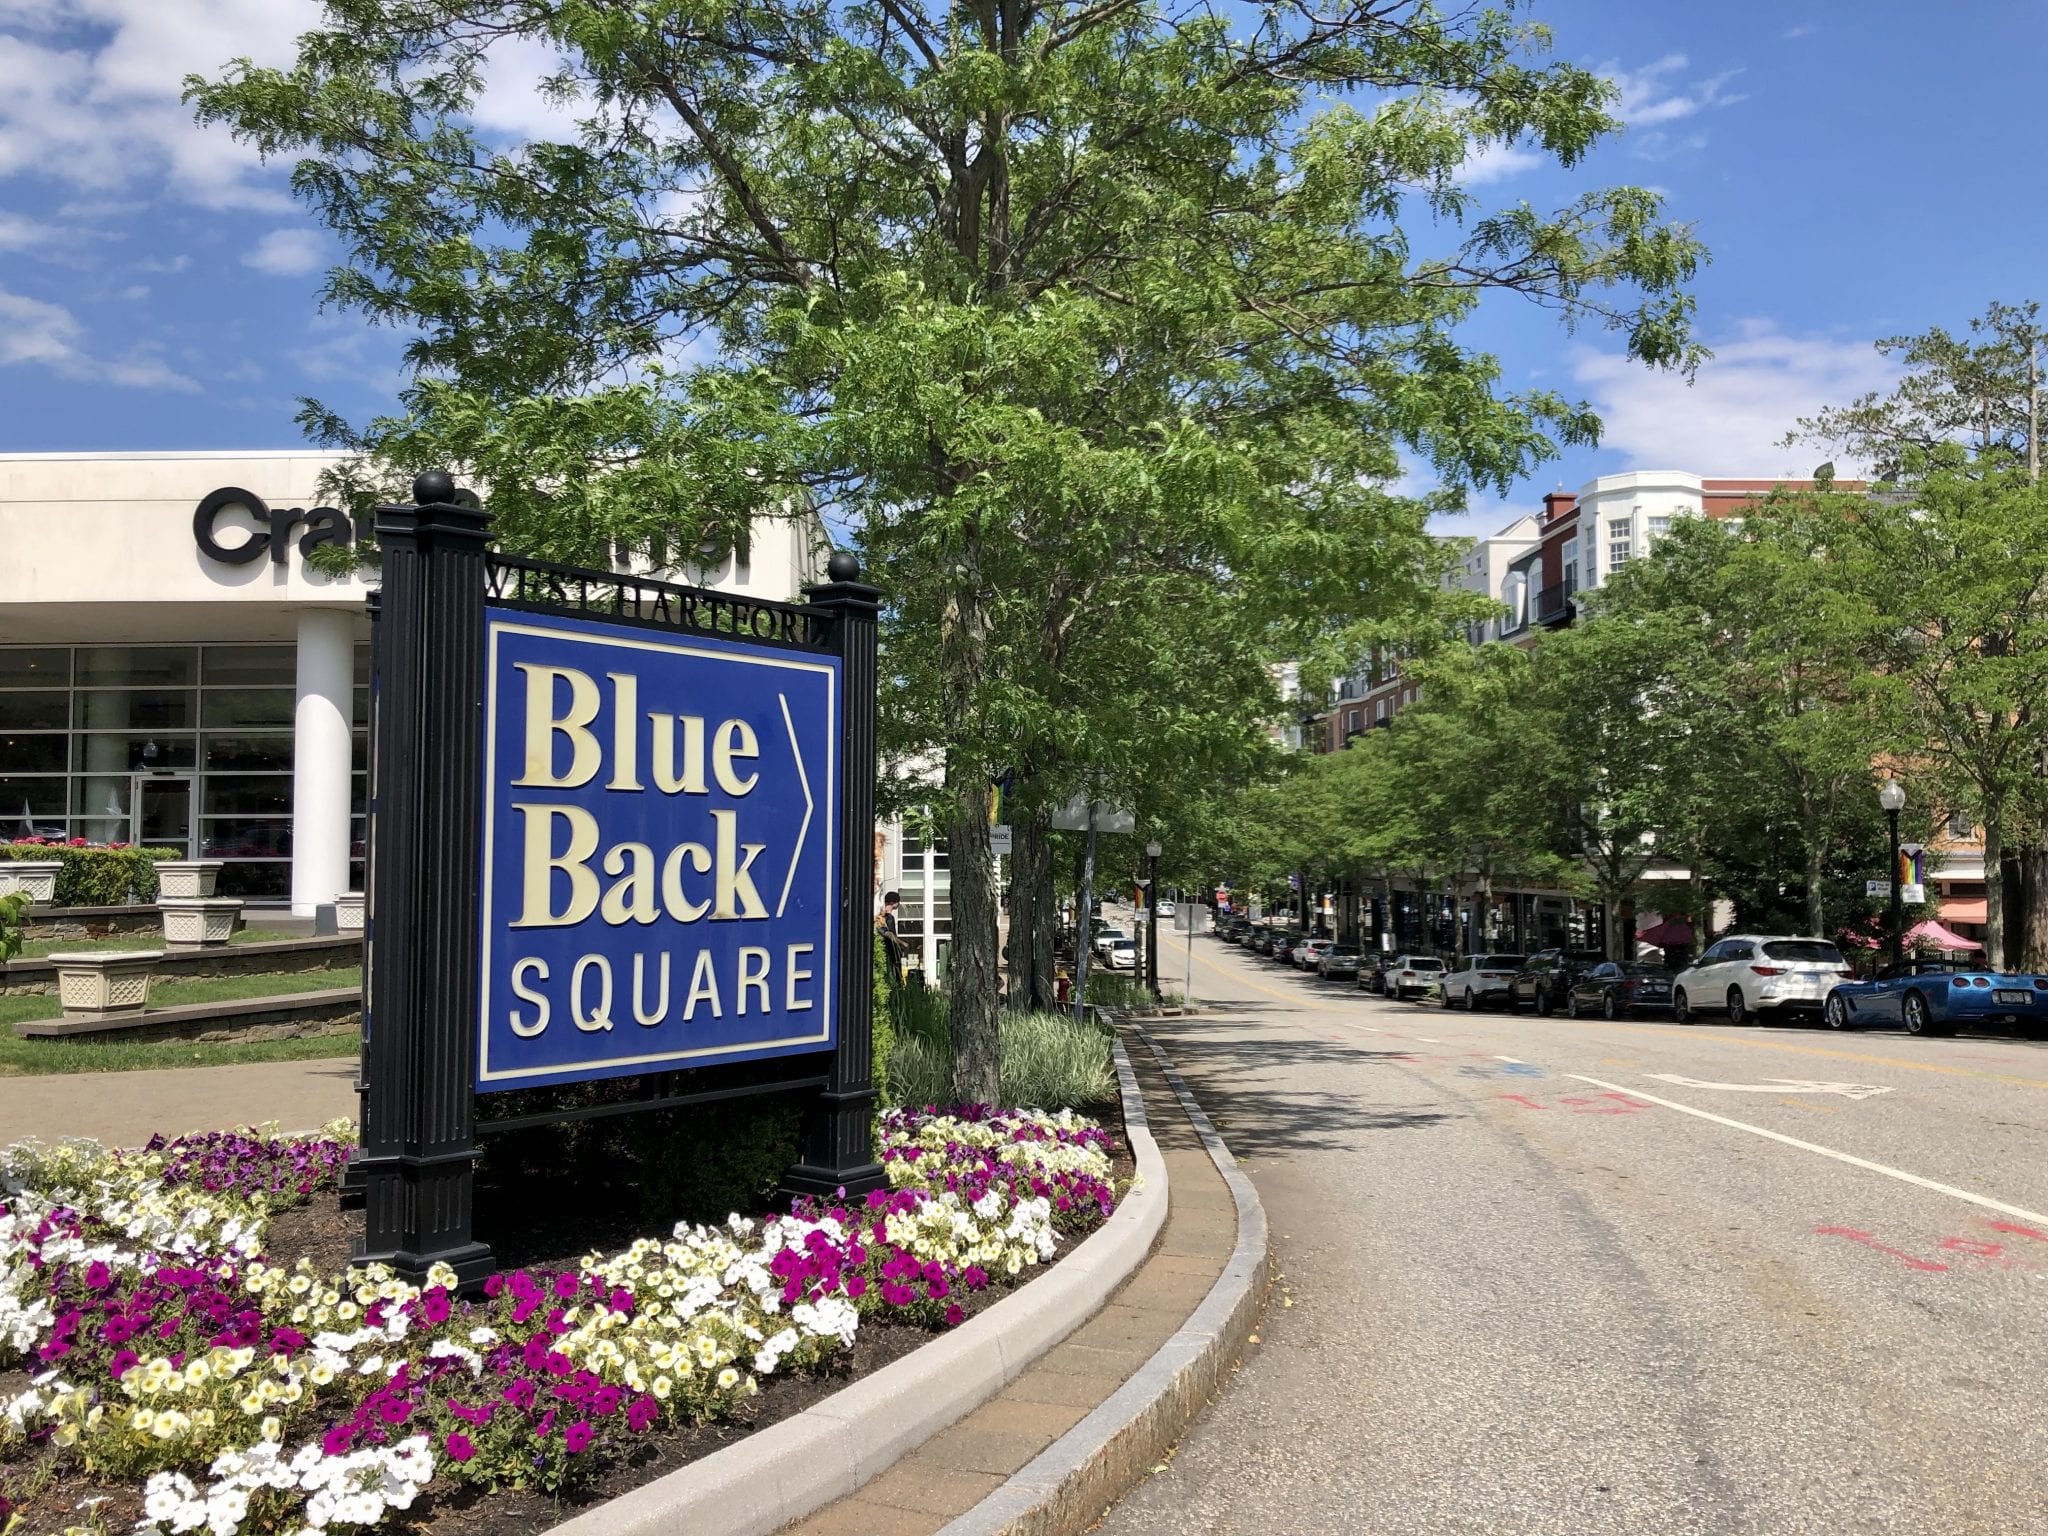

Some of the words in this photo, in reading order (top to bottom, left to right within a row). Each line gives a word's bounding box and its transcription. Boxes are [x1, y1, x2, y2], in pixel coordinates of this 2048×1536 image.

[485, 559, 598, 610] WEST
[510, 661, 760, 796] Blue
[508, 803, 770, 928] Back
[509, 942, 814, 1037] SQUARE
